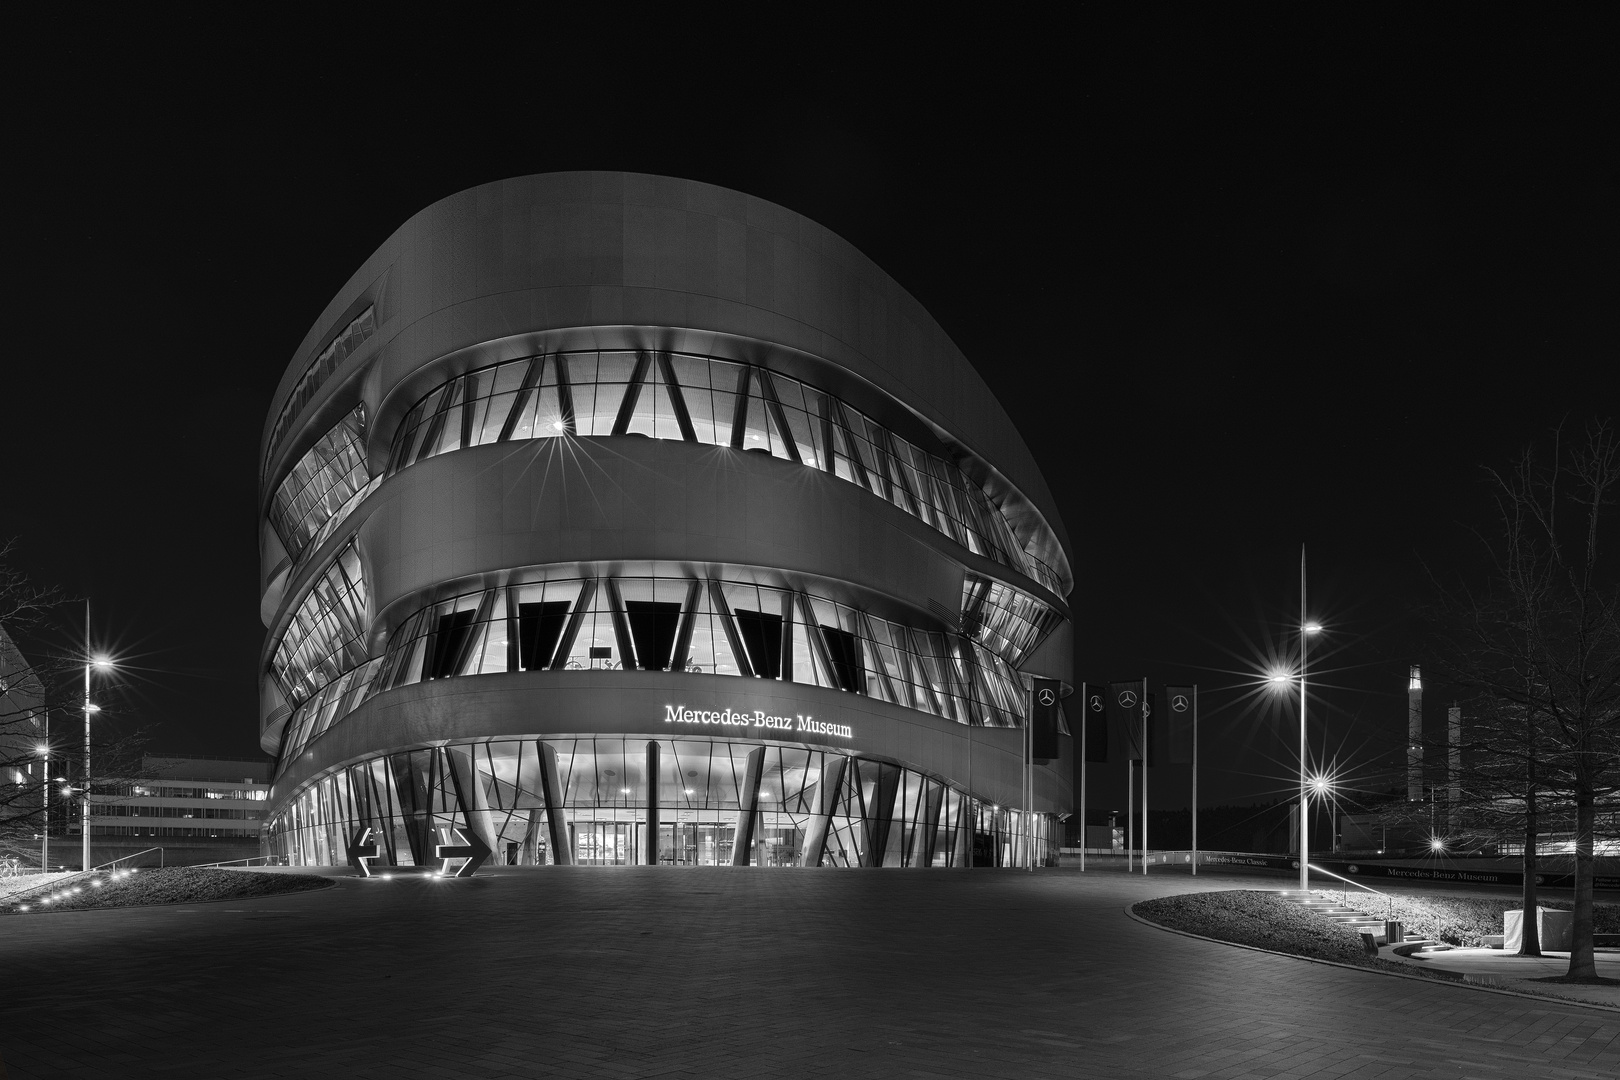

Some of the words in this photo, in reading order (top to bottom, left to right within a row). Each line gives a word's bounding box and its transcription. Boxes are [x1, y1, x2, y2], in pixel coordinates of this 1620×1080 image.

[665, 705, 792, 730] Mercedes-Benz
[797, 715, 852, 737] Museum
[1206, 855, 1246, 864] Mercedes-Benz
[1246, 858, 1268, 866] Classic
[1387, 868, 1456, 880] Mercedes-Benz
[1457, 872, 1498, 882] Museum
